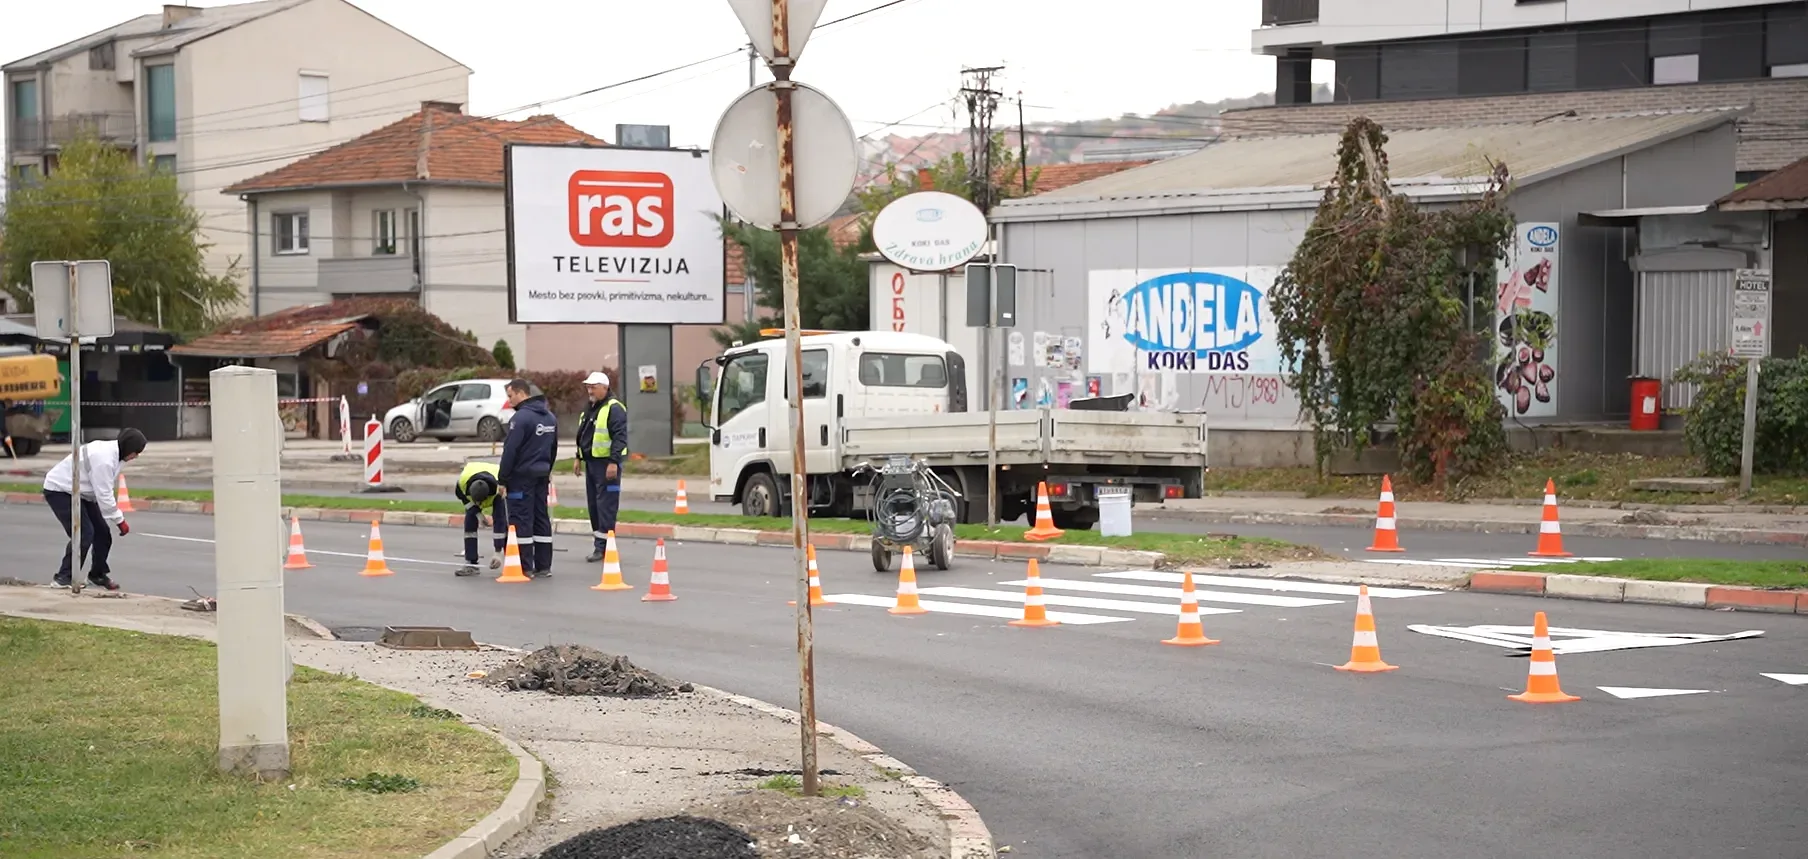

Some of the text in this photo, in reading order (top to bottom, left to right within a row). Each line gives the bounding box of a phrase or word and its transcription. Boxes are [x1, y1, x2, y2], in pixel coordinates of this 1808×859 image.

[577, 194, 665, 237] ras
[885, 240, 978, 265] Zdrava hrana
[553, 256, 690, 274] TELEVIZIJA
[1740, 281, 1766, 290] HOTEL
[528, 290, 557, 300] Mesto
[559, 290, 575, 300] bez
[577, 291, 607, 302] psovki,
[609, 291, 665, 302] primitivizma,
[1148, 351, 1249, 370] KOKI DAS
